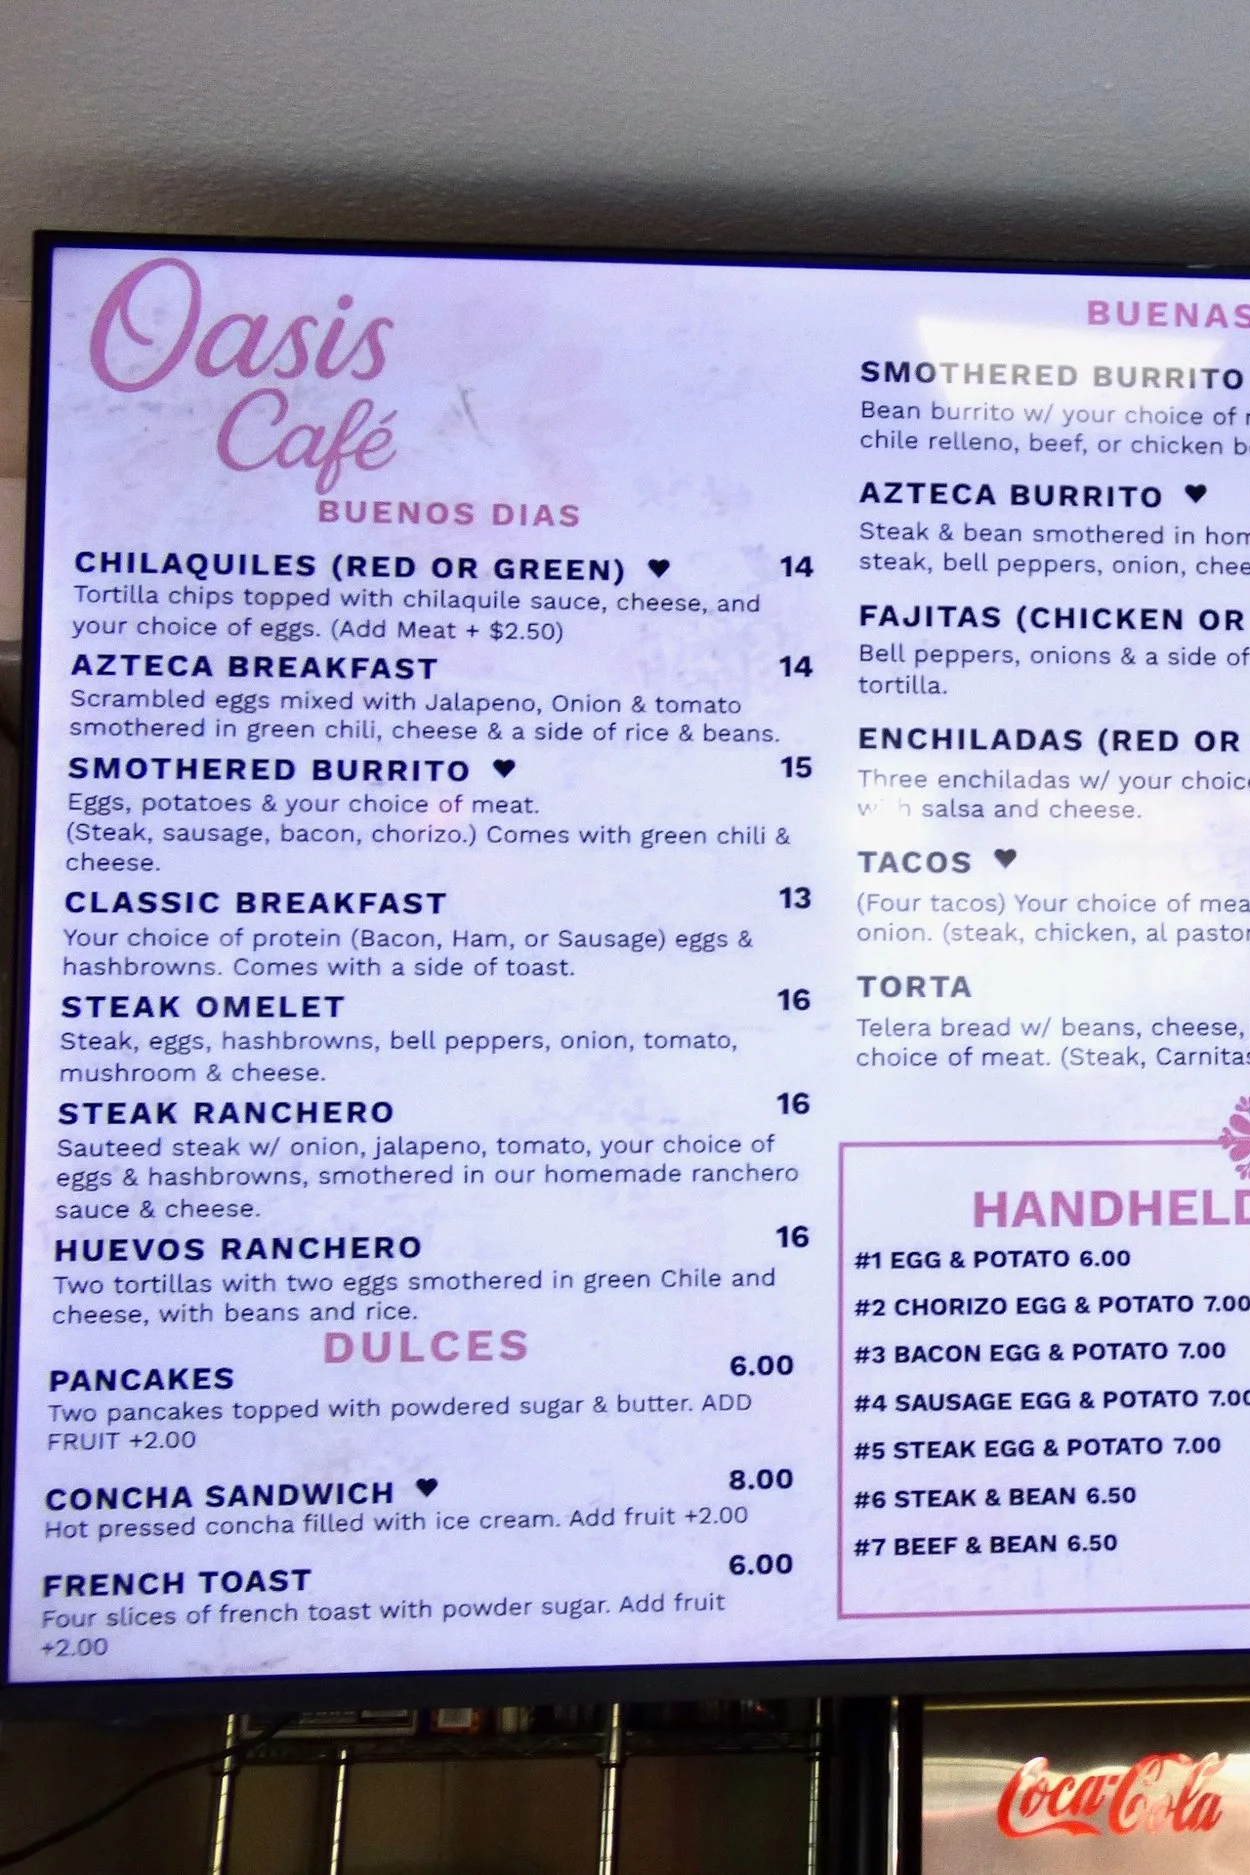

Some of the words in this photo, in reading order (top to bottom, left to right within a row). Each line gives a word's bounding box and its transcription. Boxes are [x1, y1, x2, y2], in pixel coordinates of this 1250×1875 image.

[90, 257, 395, 393] Oasis
[860, 360, 1077, 387] SMOTHERED
[1093, 366, 1244, 390] BURRITO
[217, 387, 398, 495] Café
[860, 429, 918, 450] chile
[929, 431, 1019, 454] relleno,
[1029, 432, 1087, 456] beef,
[1097, 439, 1122, 453] or
[1131, 435, 1223, 455] chicken
[859, 481, 996, 506] AZTECA
[1010, 484, 1162, 509] BURRITO
[318, 499, 474, 526] BUENOS
[492, 503, 579, 528] DIAS
[75, 551, 316, 581] CHILAQUILES
[332, 553, 416, 582] (RED
[431, 557, 478, 579] OR
[494, 558, 624, 587] GREEN)
[780, 555, 814, 578] 14
[73, 584, 159, 604] Tortilla
[168, 585, 234, 610] chips
[243, 587, 330, 611] topped
[340, 588, 393, 608] with
[403, 589, 520, 613] chilaquile
[531, 595, 607, 614] sauce,
[617, 592, 707, 615] cheese,
[717, 594, 760, 613] and
[860, 604, 1001, 629] FAJITAS
[1016, 605, 1183, 634] (CHICKEN
[1199, 608, 1245, 631] OR
[71, 653, 213, 677] AZTECA
[228, 655, 438, 680] BREAKFAST
[779, 655, 814, 678] 14
[859, 727, 1082, 751] ENCHILADAS
[1098, 727, 1179, 757] (RED
[1194, 730, 1240, 753] OR
[68, 757, 296, 781] SMOTHERED
[312, 759, 469, 782] BURRITO
[781, 756, 812, 779] 15
[69, 792, 131, 816] Eggs,
[142, 794, 252, 816] potatoes
[261, 794, 277, 813] &
[284, 798, 340, 817] your
[349, 793, 428, 813] choice
[439, 794, 463, 813] of
[472, 797, 539, 814] meat.
[857, 850, 971, 874] TACOS
[65, 891, 219, 914] CLASSIC
[236, 891, 447, 915] BREAKFAST
[779, 886, 811, 910] 13
[856, 975, 972, 998] TORTA
[61, 995, 180, 1019] STEAK
[196, 995, 345, 1018] OMELET
[777, 988, 811, 1011] 16
[58, 1101, 178, 1125] STEAK
[194, 1101, 393, 1124] RANCHERO
[777, 1092, 810, 1115] 16
[776, 1225, 809, 1248] 16
[55, 1238, 204, 1262] HUEVOS
[221, 1236, 421, 1260] RANCHERO
[854, 1251, 881, 1270] #1
[891, 1251, 941, 1270] EGG
[949, 1250, 966, 1269] &
[974, 1249, 1070, 1268] POTATO
[1079, 1249, 1131, 1268] 6.00
[324, 1329, 527, 1364] DULCES
[730, 1354, 794, 1377] 6.00
[50, 1367, 234, 1392] PANCAKES
[854, 1394, 888, 1413] #4
[895, 1392, 1012, 1413] SAUSAGE
[1020, 1391, 1071, 1410] EGG
[1079, 1391, 1095, 1410] &
[1103, 1389, 1199, 1409] POTATO
[48, 1432, 121, 1451] FRUIT
[129, 1430, 196, 1449] +2.00
[729, 1468, 793, 1491] 8.00
[45, 1485, 193, 1511] CONCHA
[205, 1481, 393, 1508] SANDWICH
[729, 1553, 793, 1576] 6.00
[43, 1571, 184, 1598] FRENCH
[198, 1568, 312, 1594] TOAST
[41, 1637, 108, 1657] +2.00
[997, 1752, 1222, 1838] Coca-Cola
